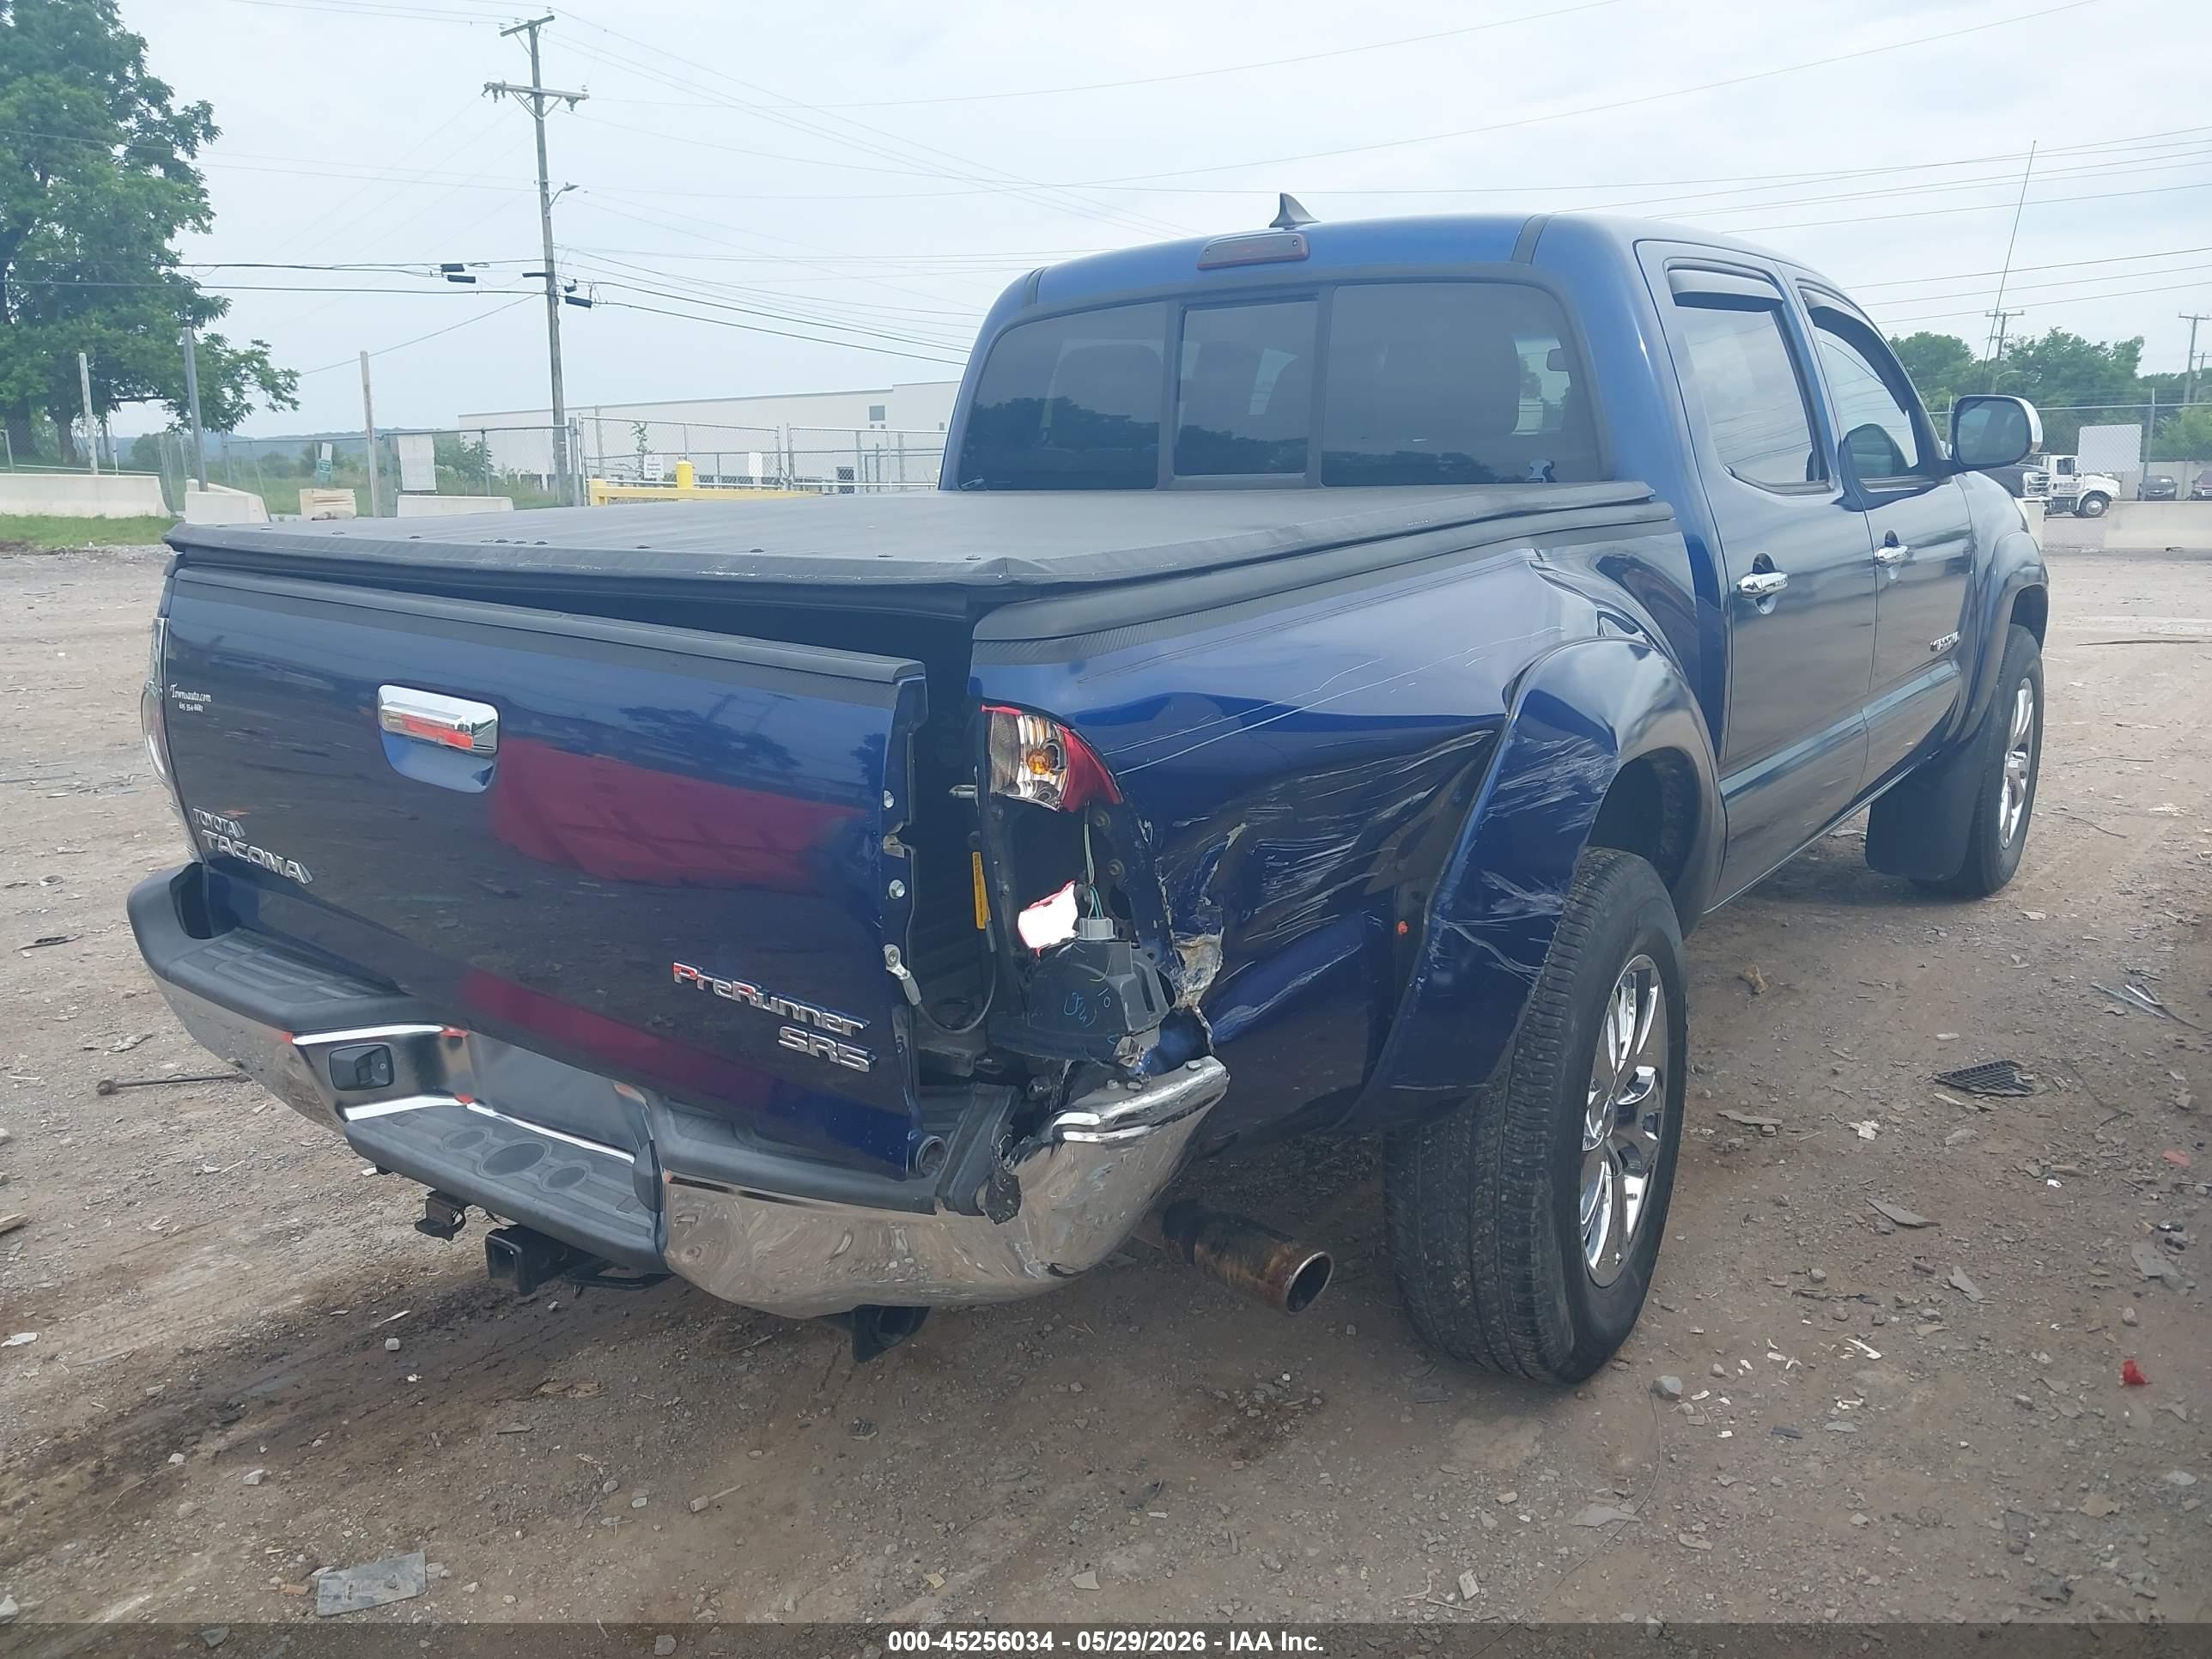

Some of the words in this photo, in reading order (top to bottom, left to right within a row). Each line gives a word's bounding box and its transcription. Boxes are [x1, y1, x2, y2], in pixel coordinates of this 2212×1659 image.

[192, 807, 246, 838] TOYOTA
[201, 829, 313, 884] TACOMA
[672, 961, 870, 1036] PreRunner
[778, 1024, 877, 1073] SR5
